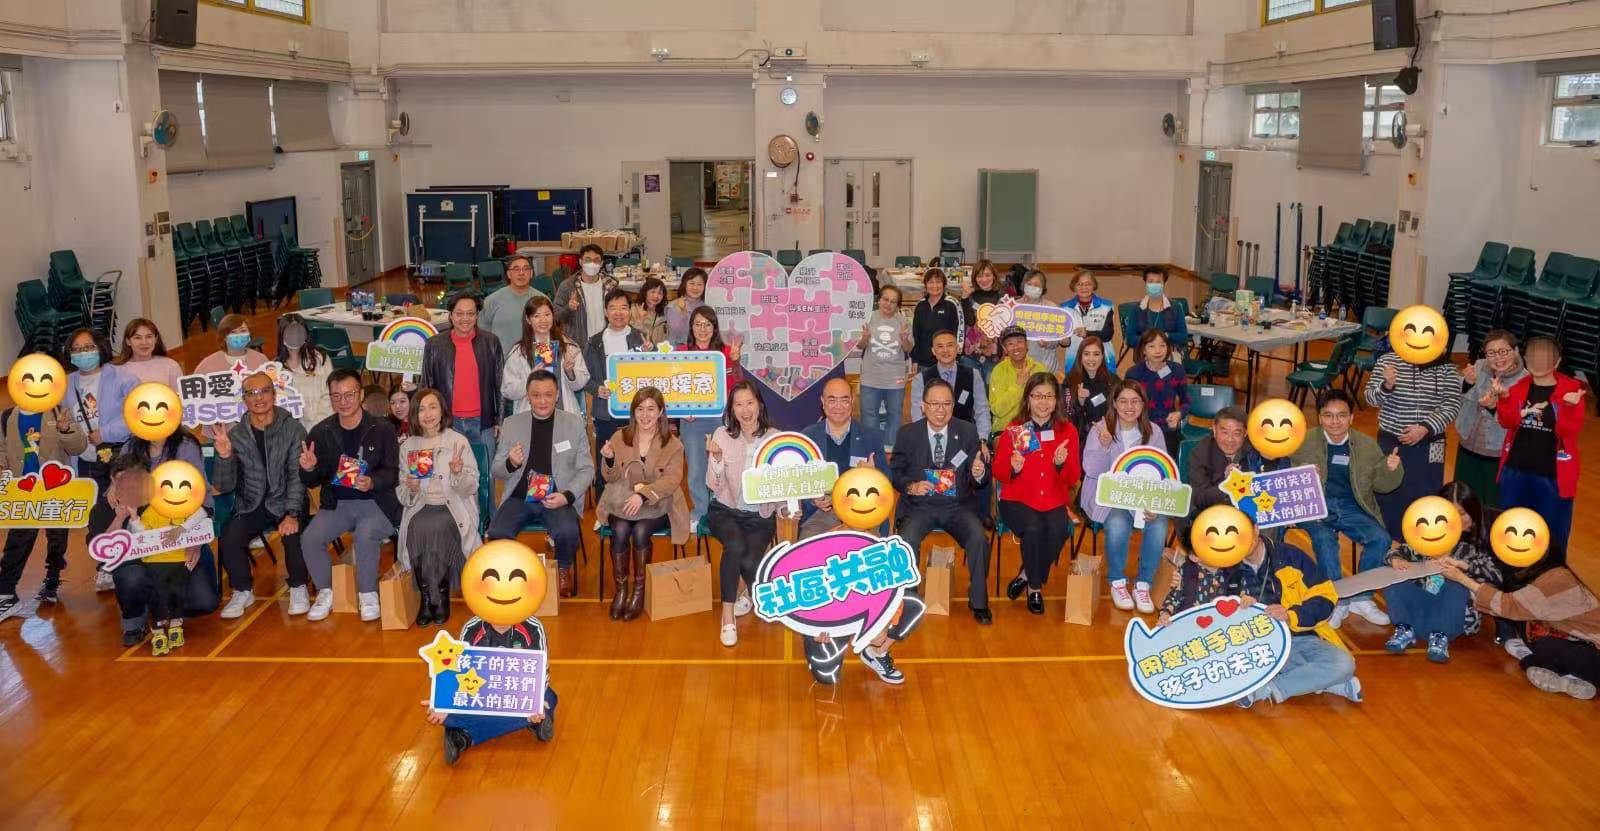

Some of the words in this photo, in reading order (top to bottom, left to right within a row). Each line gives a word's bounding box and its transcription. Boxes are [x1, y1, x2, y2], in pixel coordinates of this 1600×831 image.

[180, 374, 235, 399] 用愛
[765, 463, 818, 481] 在城市中
[758, 479, 827, 498] 親親大自然
[1119, 478, 1172, 494] 在城市中
[1249, 472, 1313, 494] 孩子的笑容
[1110, 490, 1177, 511] 親親大自然
[1278, 487, 1317, 504] 是我們
[0, 498, 89, 522] SEN童行
[1255, 502, 1320, 524] 最大的動力
[130, 543, 160, 556] Ahava
[186, 532, 212, 545] Heart
[756, 540, 914, 615] 社區共融
[1138, 613, 1275, 678] 用愛攜手創造
[456, 654, 538, 674] 孩子的笑容
[1157, 643, 1277, 699] 孩子的未來
[487, 674, 537, 692] 是我們
[453, 691, 535, 711] 最大的動力
